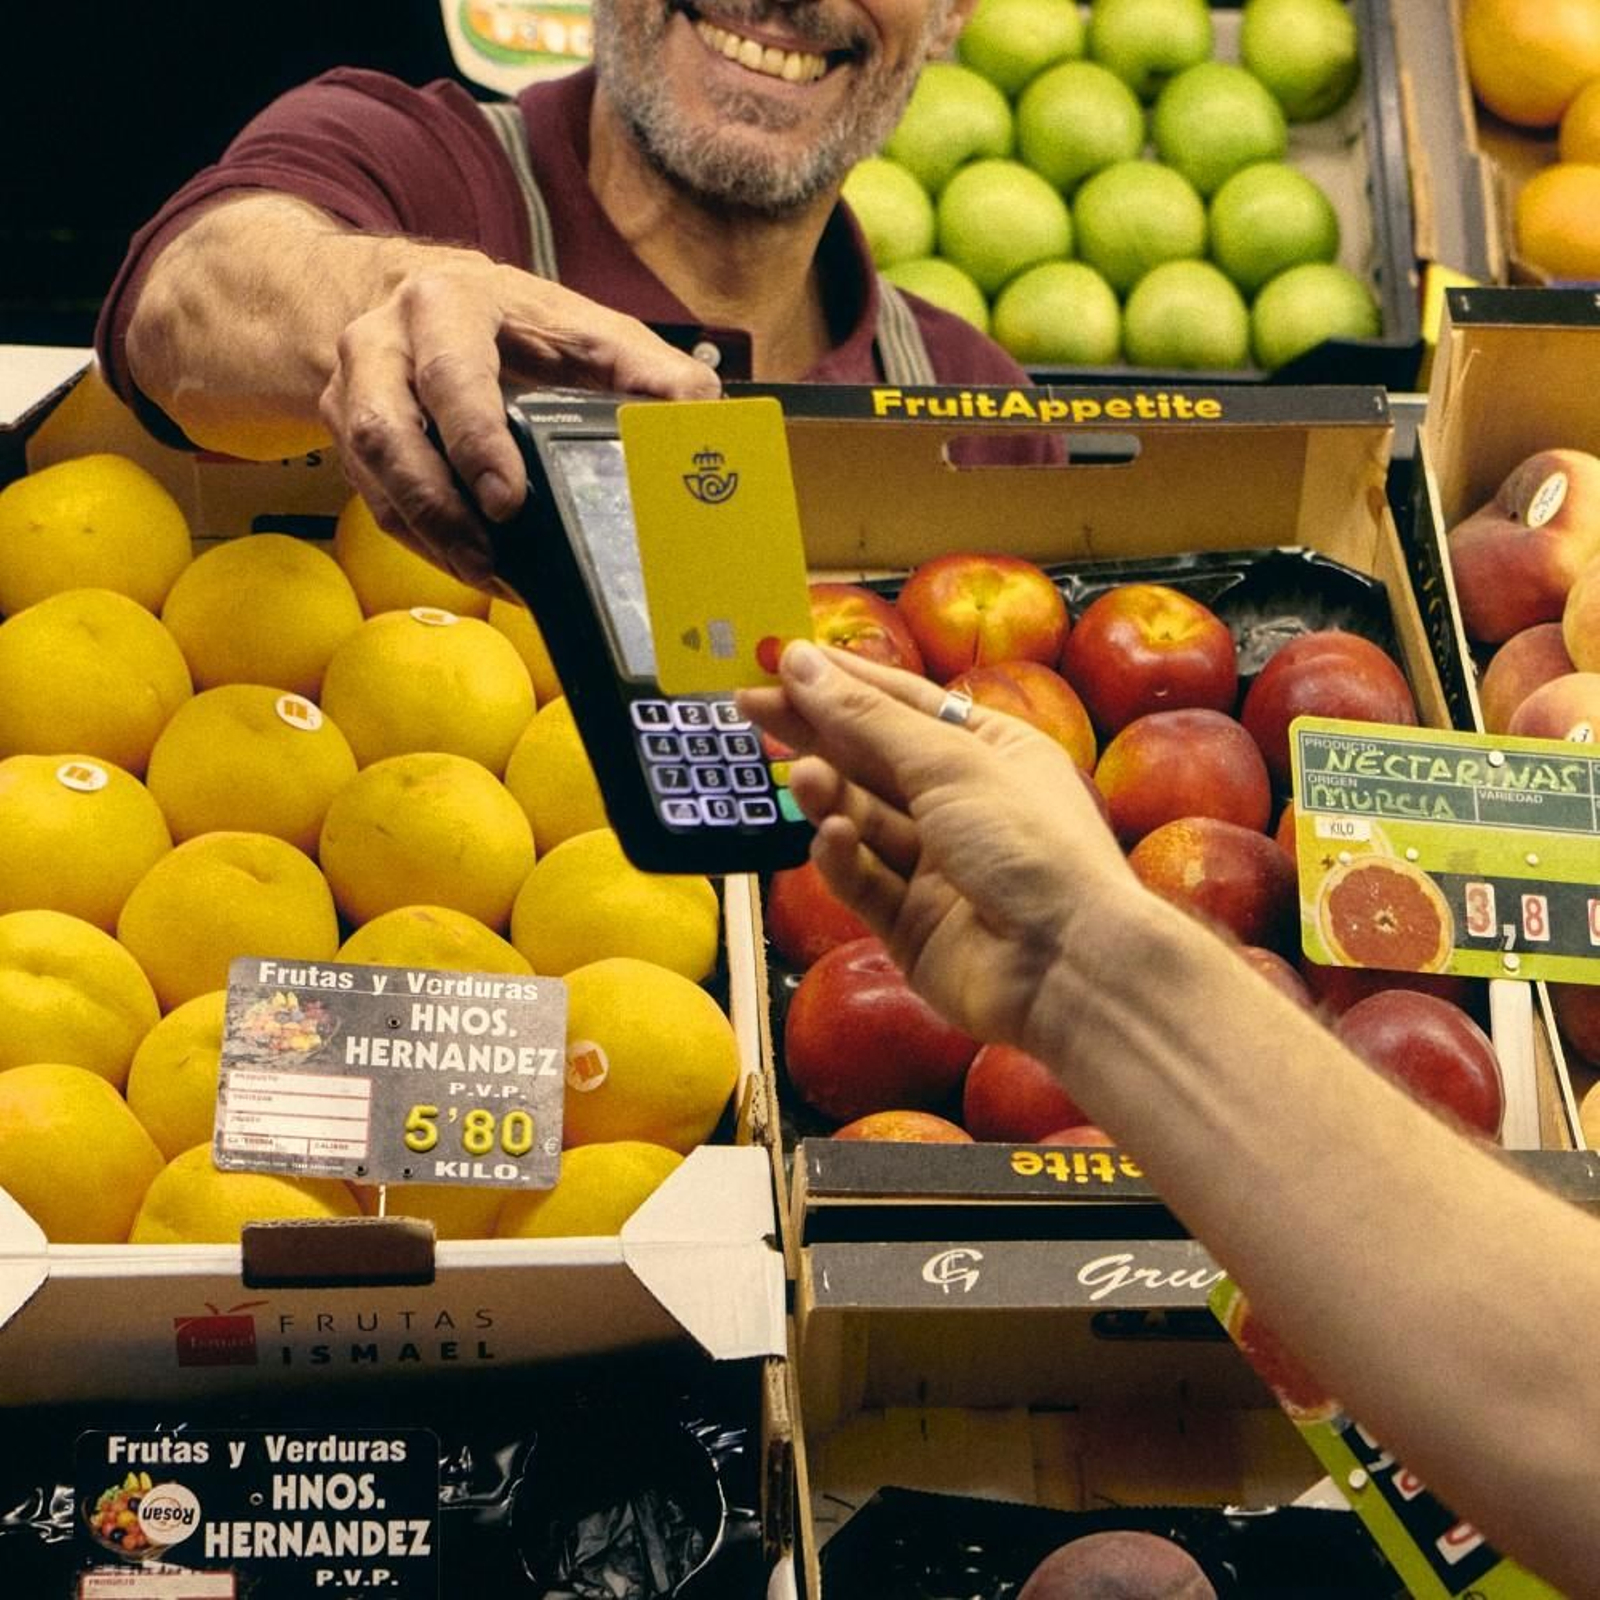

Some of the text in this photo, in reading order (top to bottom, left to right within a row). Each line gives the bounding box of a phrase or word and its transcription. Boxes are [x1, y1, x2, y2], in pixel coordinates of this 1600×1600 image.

[871, 388, 1222, 423] FruitAppetite
[647, 706, 740, 724] 1 2 3
[657, 738, 670, 753] 4
[734, 738, 748, 754] 6
[1304, 737, 1377, 752] PRODUCTO
[666, 769, 757, 788] 7 8 9
[1307, 774, 1359, 788] ORIGEN
[1325, 748, 1587, 794] NECTARINAS
[714, 801, 728, 818] 0
[1478, 789, 1543, 804] VARIEDAD
[258, 961, 539, 1001] Frutas y Verduras
[410, 1003, 518, 1038] HNOS.
[345, 1035, 559, 1077] HERNANDEZ
[449, 1081, 527, 1100] P.V.P.
[404, 1104, 535, 1157] 5'80
[434, 1160, 531, 1181] KILO.
[1077, 1253, 1227, 1301] Gru
[279, 1308, 496, 1334] FRUTAS
[281, 1340, 496, 1366] ISMAEL
[108, 1434, 407, 1469] Frutas y Verduras
[272, 1472, 386, 1511] HNOS.
[142, 1506, 195, 1526] Rosan
[204, 1519, 431, 1558] HERNANDEZ
[315, 1568, 399, 1587] P.V.P.
